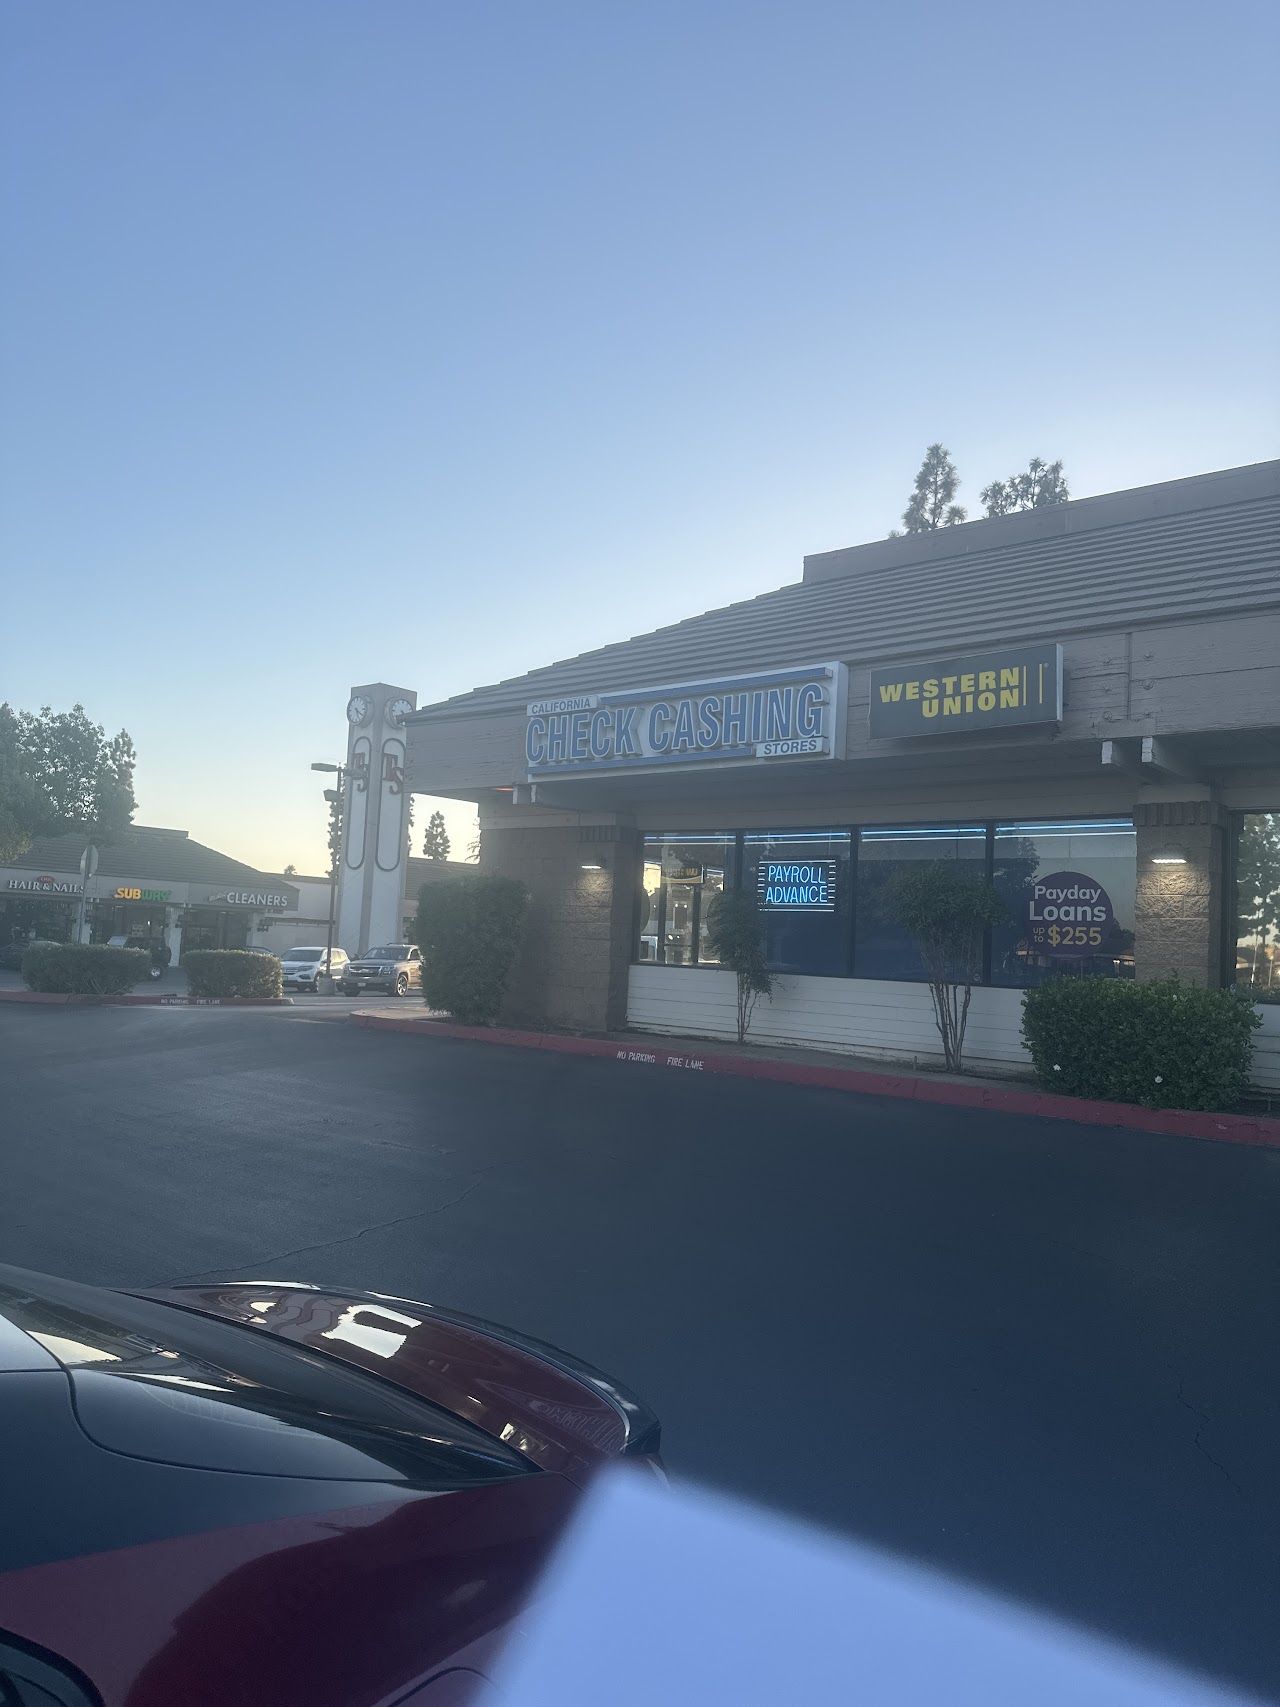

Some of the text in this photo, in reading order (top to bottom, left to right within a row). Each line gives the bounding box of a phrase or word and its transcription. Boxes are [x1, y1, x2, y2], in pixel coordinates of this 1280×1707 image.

[880, 667, 1019, 703] WESTERN
[531, 697, 591, 715] CALIFORNIA
[922, 688, 1019, 718] UNION
[526, 683, 824, 764] CHECK CASHING
[763, 740, 817, 756] STORES
[768, 865, 827, 884] PAYROLL
[8, 880, 40, 891] HAIR
[42, 883, 51, 891] &
[114, 887, 172, 901] SUBWAY
[765, 886, 828, 903] ADVANCE
[1034, 885, 1102, 904] Payday
[226, 892, 288, 907] CLEANERS
[1029, 901, 1107, 922] Loans
[1033, 927, 1046, 936] up
[1033, 935, 1044, 943] to
[1047, 924, 1102, 947] $255
[616, 1050, 705, 1071] NO PARKING FIRE LANE
